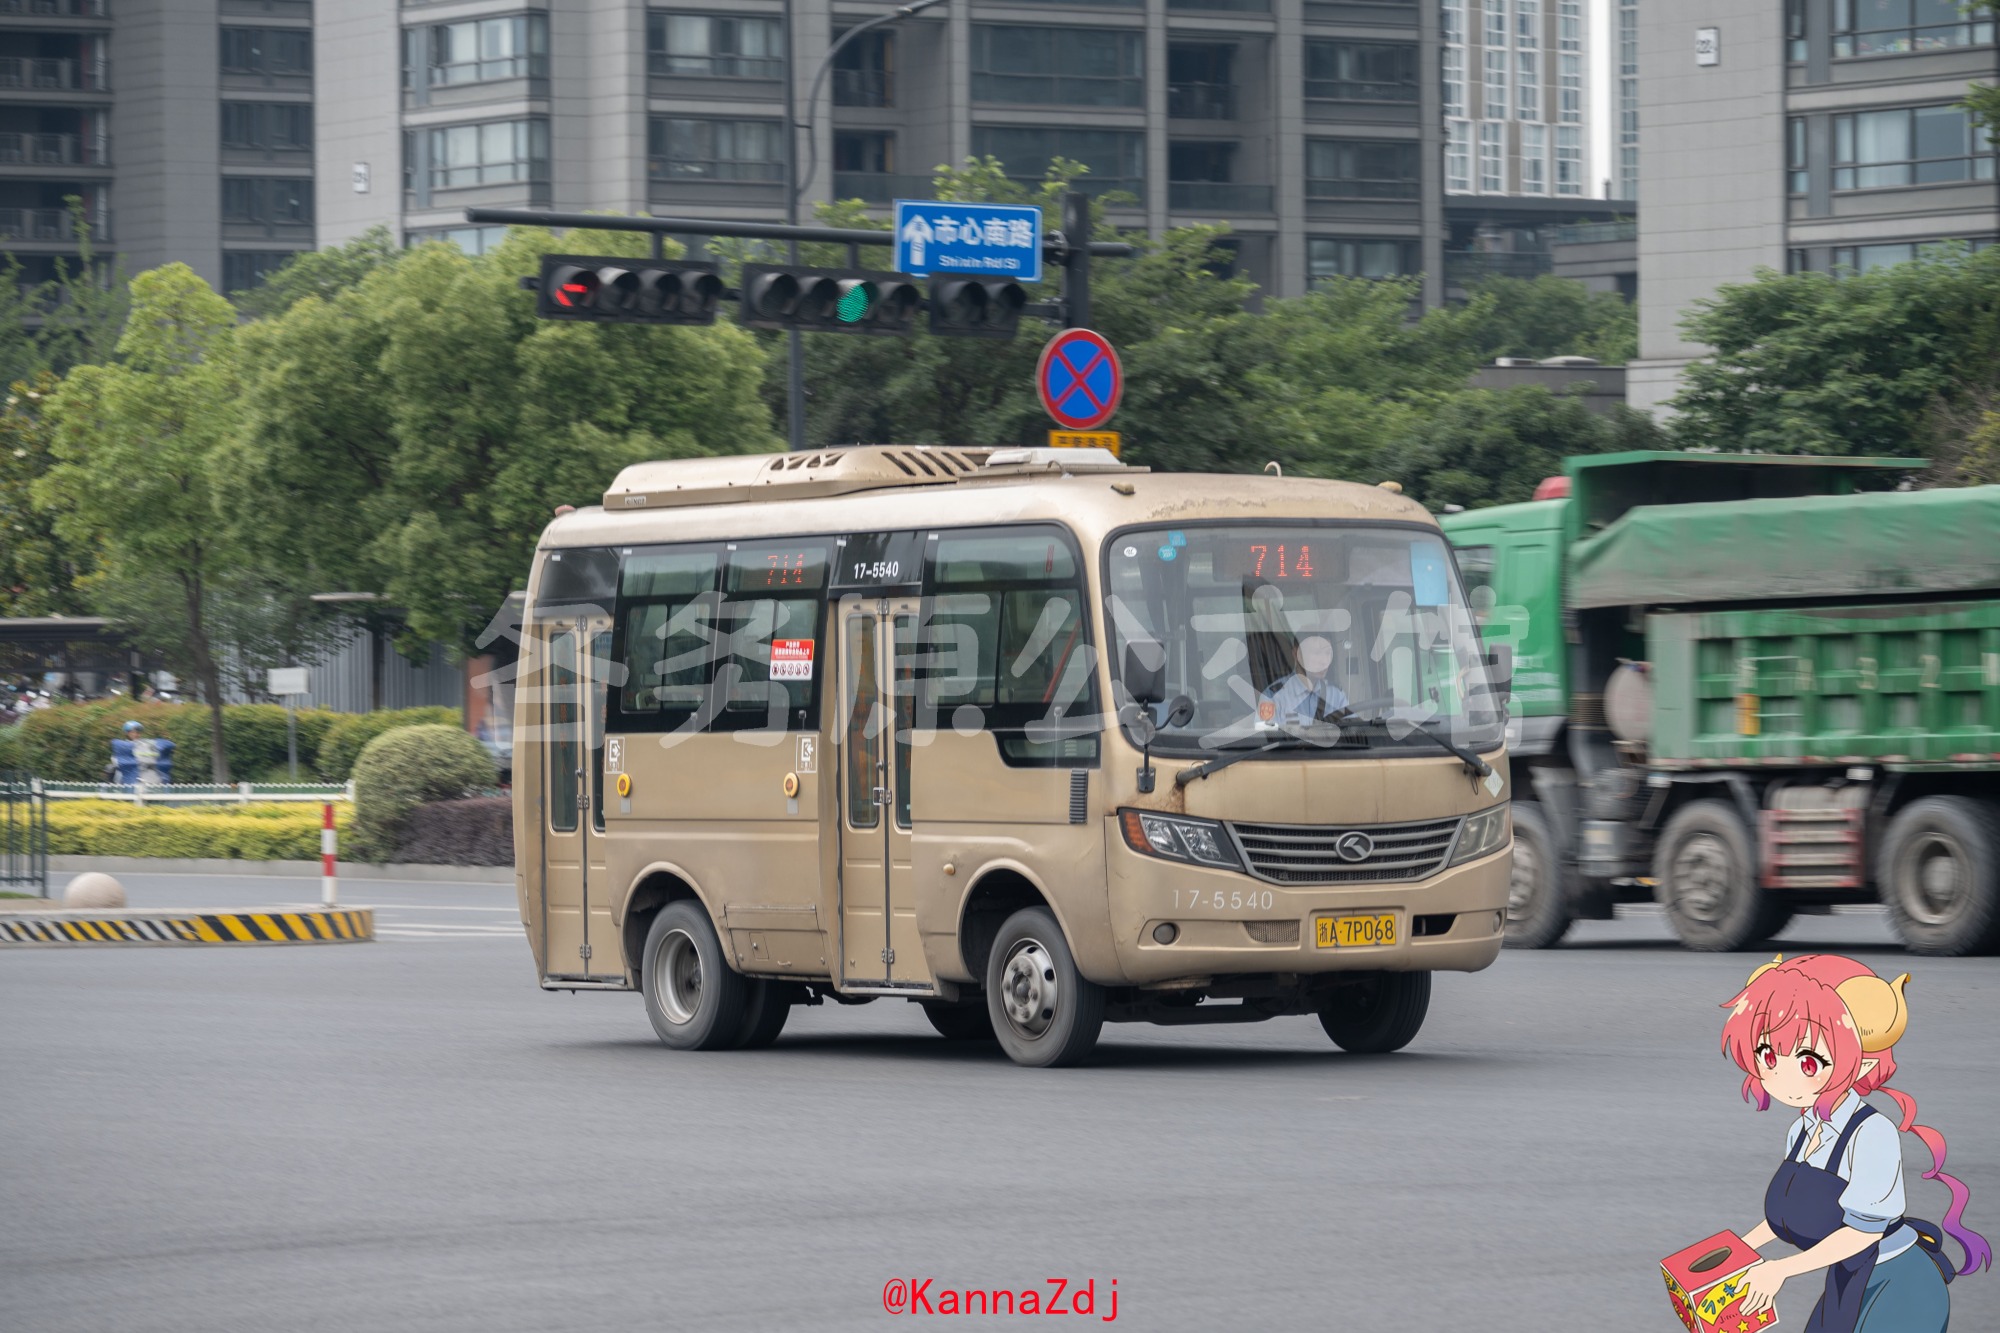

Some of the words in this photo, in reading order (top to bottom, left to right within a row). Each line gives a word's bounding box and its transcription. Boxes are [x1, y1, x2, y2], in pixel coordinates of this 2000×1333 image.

[932, 215, 1034, 248] 市心南路
[767, 553, 804, 585] 714
[853, 560, 900, 580] 17-5540
[1250, 545, 1314, 577] 714
[1172, 889, 1274, 912] 17-5540
